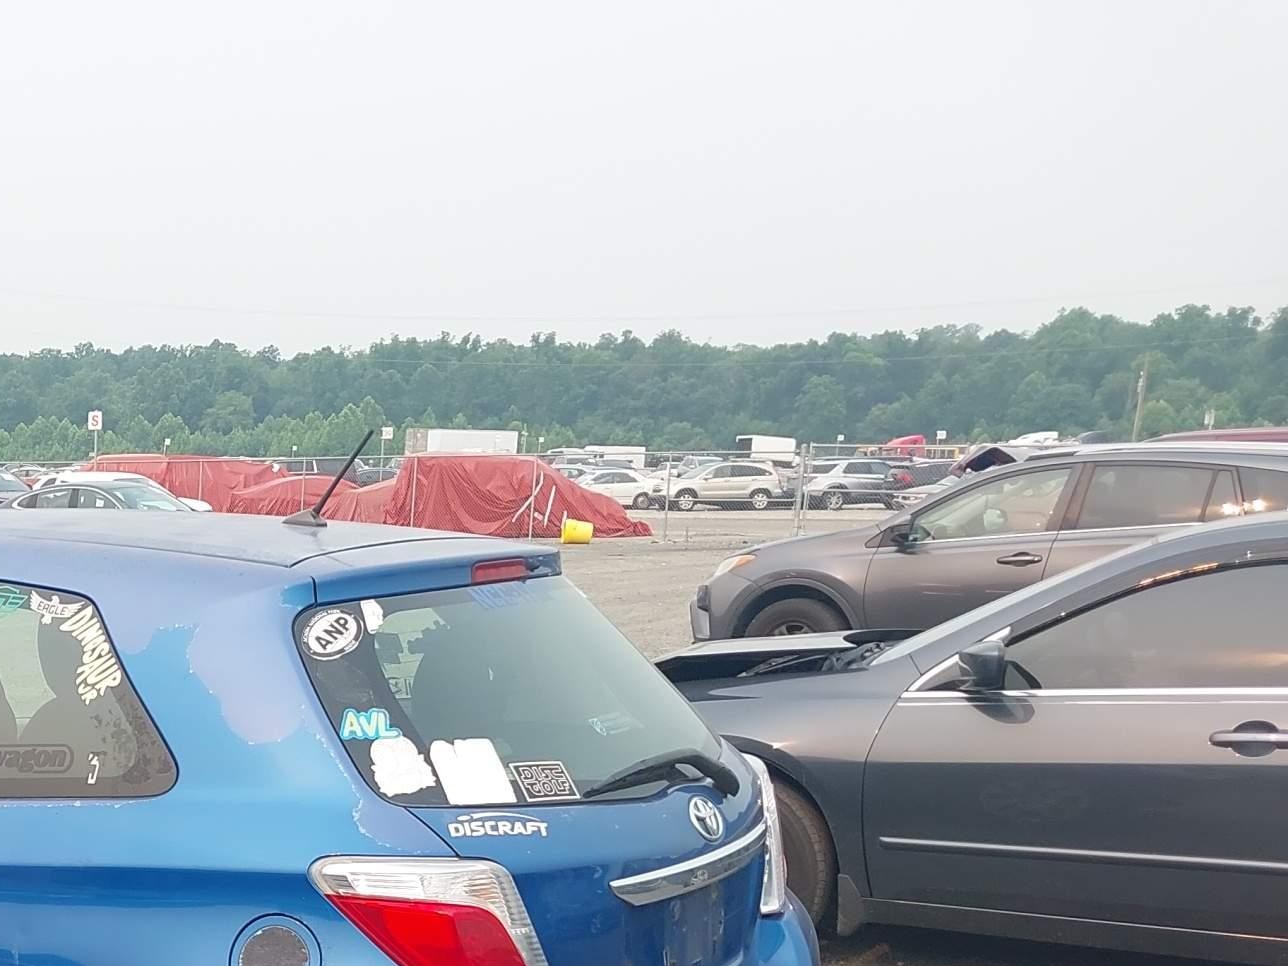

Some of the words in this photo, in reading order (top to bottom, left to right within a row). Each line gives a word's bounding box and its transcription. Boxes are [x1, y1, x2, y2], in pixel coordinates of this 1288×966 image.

[91, 415, 99, 427] S
[36, 600, 69, 616] EAGLE
[314, 616, 350, 651] ANP
[59, 605, 122, 697] DINOSAUR
[342, 710, 400, 738] AVL
[519, 766, 566, 781] DISC
[448, 819, 548, 837] DISCRAFT
